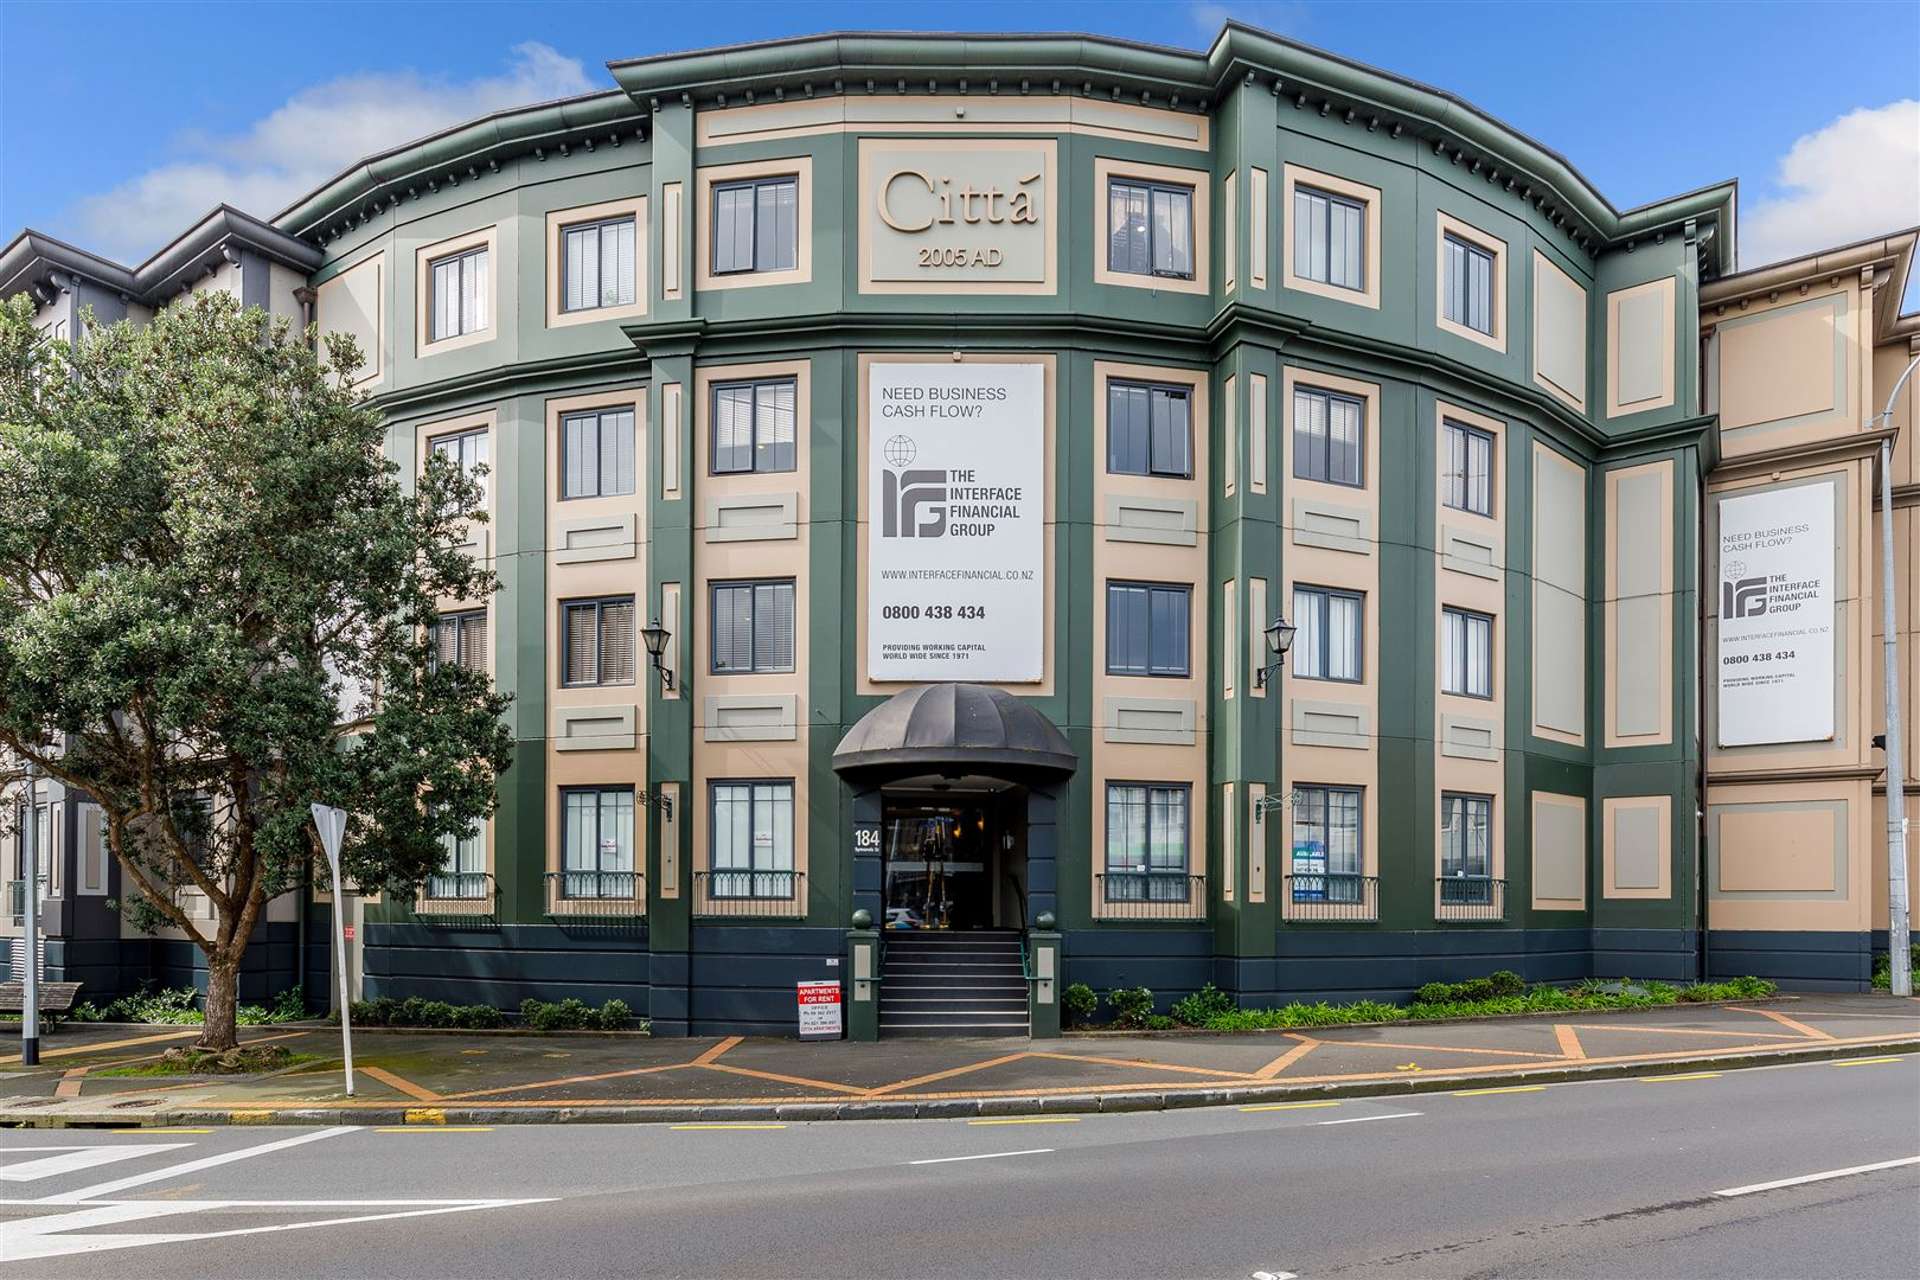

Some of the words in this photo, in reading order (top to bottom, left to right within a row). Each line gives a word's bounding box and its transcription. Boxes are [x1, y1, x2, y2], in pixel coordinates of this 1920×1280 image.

[878, 171, 1041, 233] Cittá
[918, 248, 968, 267] 2005
[970, 248, 1002, 267] AD
[882, 387, 924, 401] NEED
[928, 387, 1007, 401] BUSINESS
[882, 405, 925, 418] CASH
[930, 405, 983, 418] FLOW?
[950, 470, 976, 482] THE
[950, 488, 1022, 500] INTERFACE
[950, 506, 1020, 518] FINANCIAL
[950, 524, 995, 537] GROUP
[1723, 533, 1752, 543] NEED
[1754, 524, 1809, 538] BUSINESS
[1723, 543, 1752, 553] CASH
[1755, 537, 1793, 548] FLOW?
[881, 570, 1034, 580] WWW.INTERFACEFINANCIAL.CO.NZ
[1769, 574, 1787, 583] THE
[1769, 579, 1821, 593] INTERFACE
[1769, 590, 1819, 603] FINANCIAL
[882, 606, 920, 619] 0800
[925, 606, 953, 619] 438
[957, 606, 986, 619] 434
[1769, 603, 1801, 614] GROUP
[1723, 655, 1749, 665] 0800
[1752, 653, 1772, 662] 438
[1775, 651, 1795, 660] 434
[855, 830, 880, 846] 184
